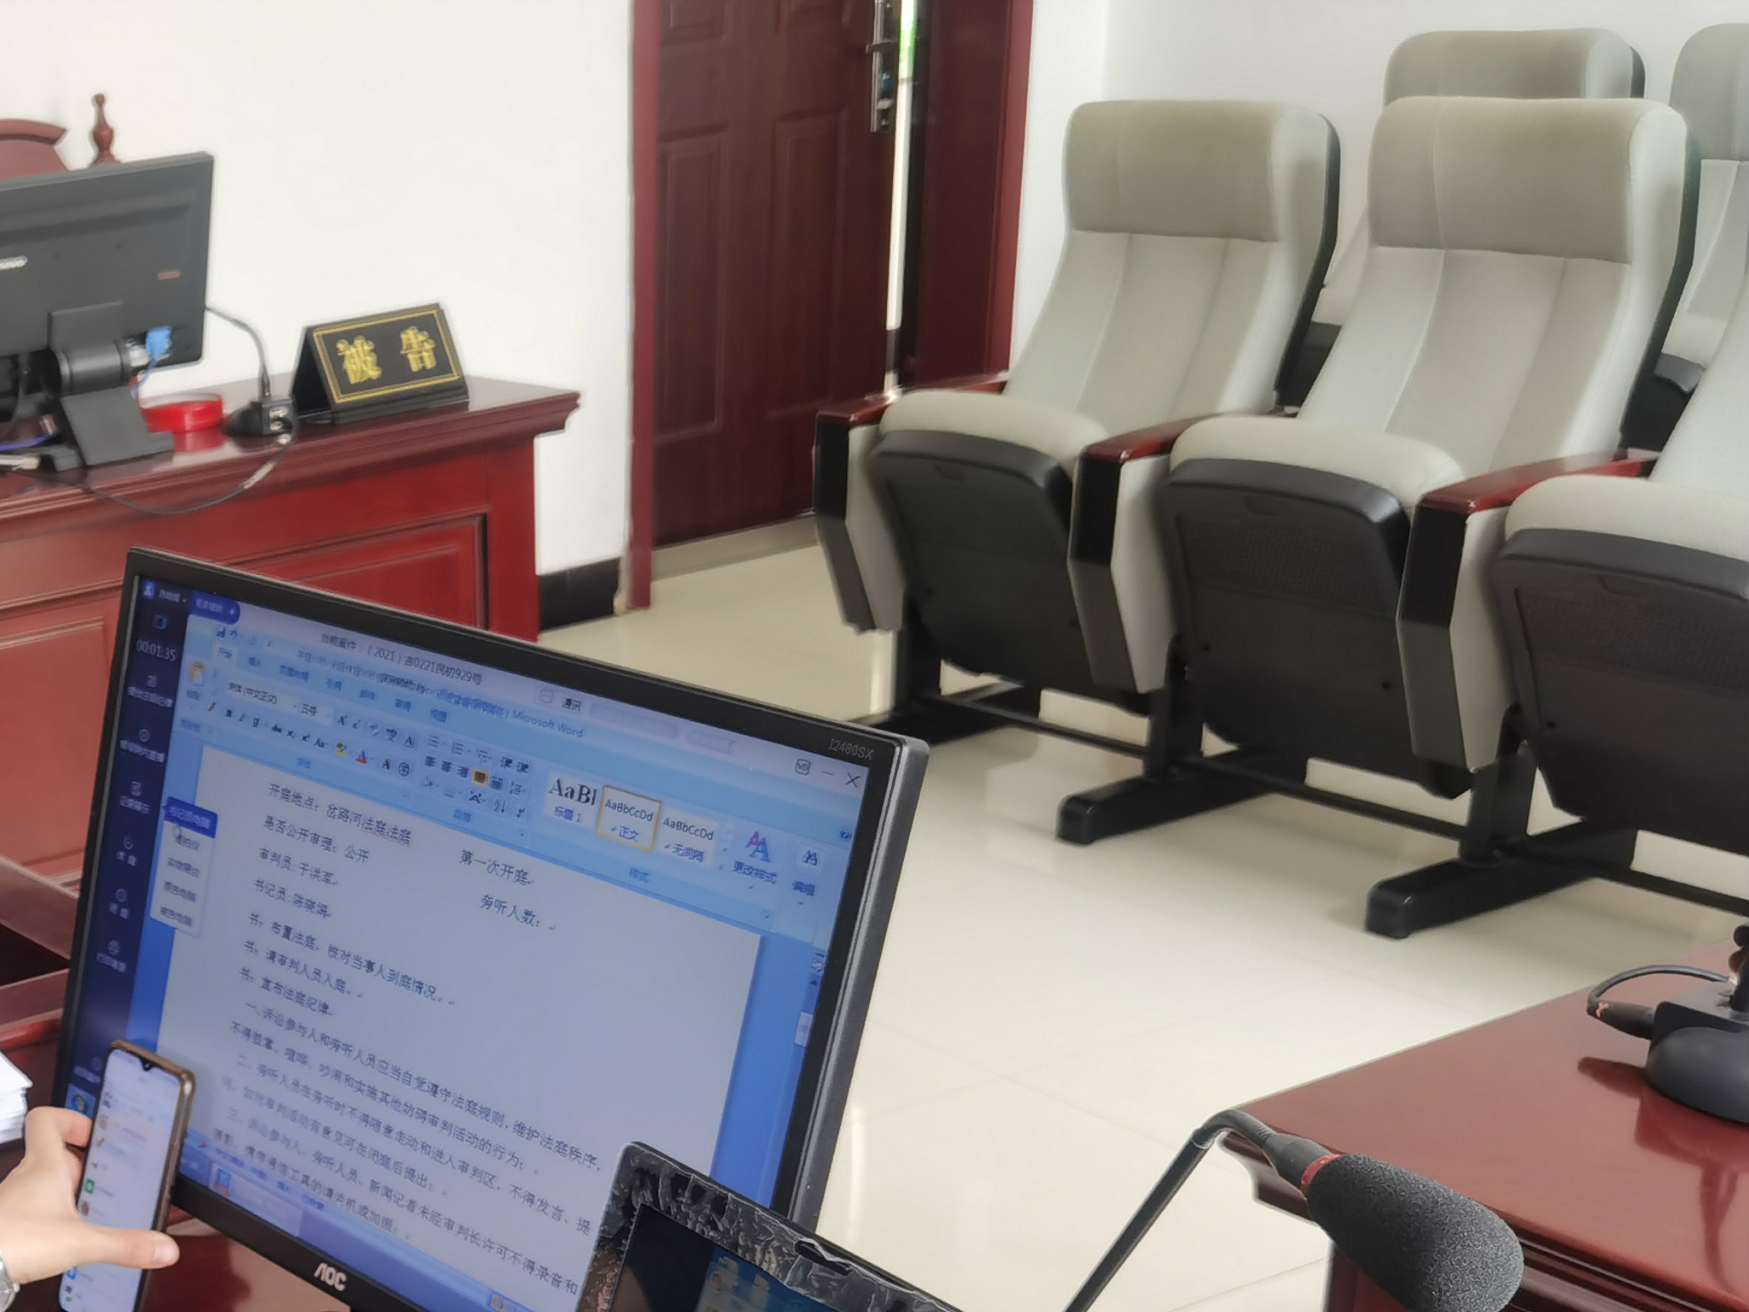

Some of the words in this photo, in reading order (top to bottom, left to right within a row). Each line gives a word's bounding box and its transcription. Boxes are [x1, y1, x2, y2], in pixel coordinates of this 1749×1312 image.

[336, 325, 437, 385] 被告
[136, 639, 177, 662] 00:01:35
[557, 720, 585, 738] Word
[604, 799, 654, 822] AaBbCcDd
[663, 817, 714, 841] AaBbCcDd
[458, 850, 529, 886] 第一次开庭
[481, 894, 541, 928] 旁听人数:
[314, 1262, 347, 1291] AOC
